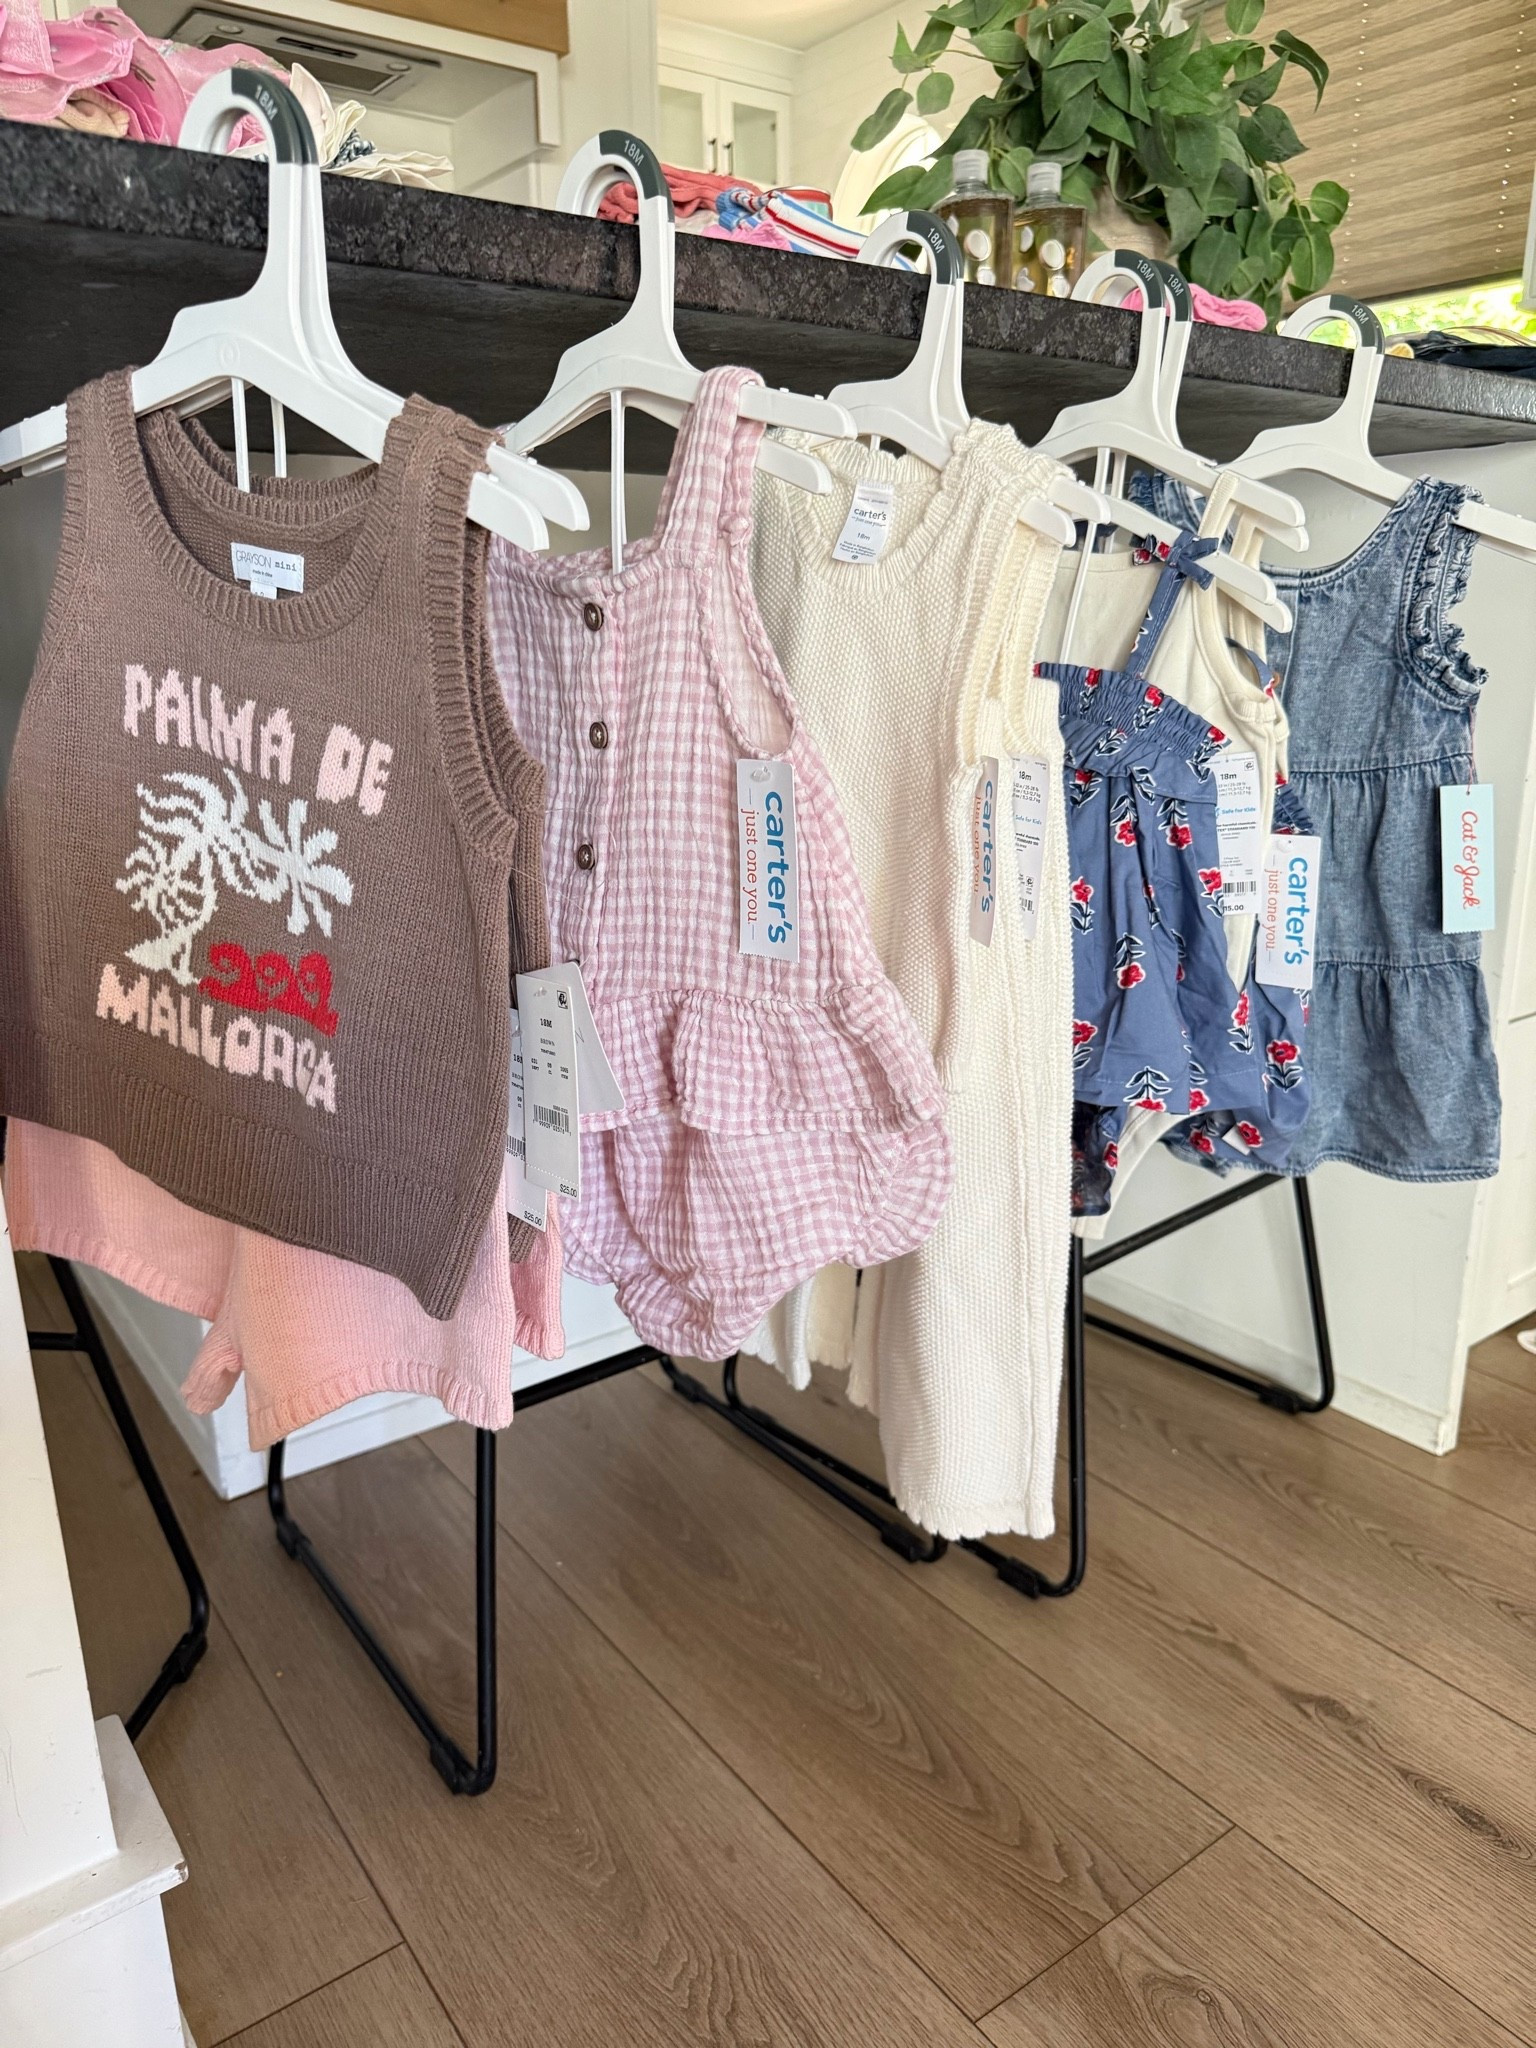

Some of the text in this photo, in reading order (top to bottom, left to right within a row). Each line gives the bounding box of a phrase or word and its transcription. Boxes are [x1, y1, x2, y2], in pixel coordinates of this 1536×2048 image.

[254, 84, 278, 120] 18M
[623, 139, 645, 166] 18M
[927, 227, 945, 254] 18M
[1136, 259, 1155, 282] 18M
[1167, 273, 1185, 297] 18M
[1351, 304, 1370, 325] 18M
[853, 508, 887, 521] carter's
[857, 532, 871, 541] 18m
[235, 550, 297, 572] GRAYSON mini
[123, 664, 394, 816] PALMA DE
[1018, 770, 1032, 781] 18m
[974, 796, 982, 826] just
[1032, 817, 1042, 825] Kids
[740, 808, 759, 845] just
[981, 780, 994, 913] carter's
[746, 849, 758, 884] one
[764, 791, 793, 944] carter's
[1453, 811, 1481, 910] Cat & Jack
[1264, 869, 1282, 894] just
[1266, 897, 1278, 923] one
[1284, 857, 1310, 965] carter's
[540, 1018, 553, 1029] 18M
[96, 963, 336, 1114] MALLORCA
[559, 1183, 578, 1198] $25.00
[523, 1210, 542, 1227] $25.00
